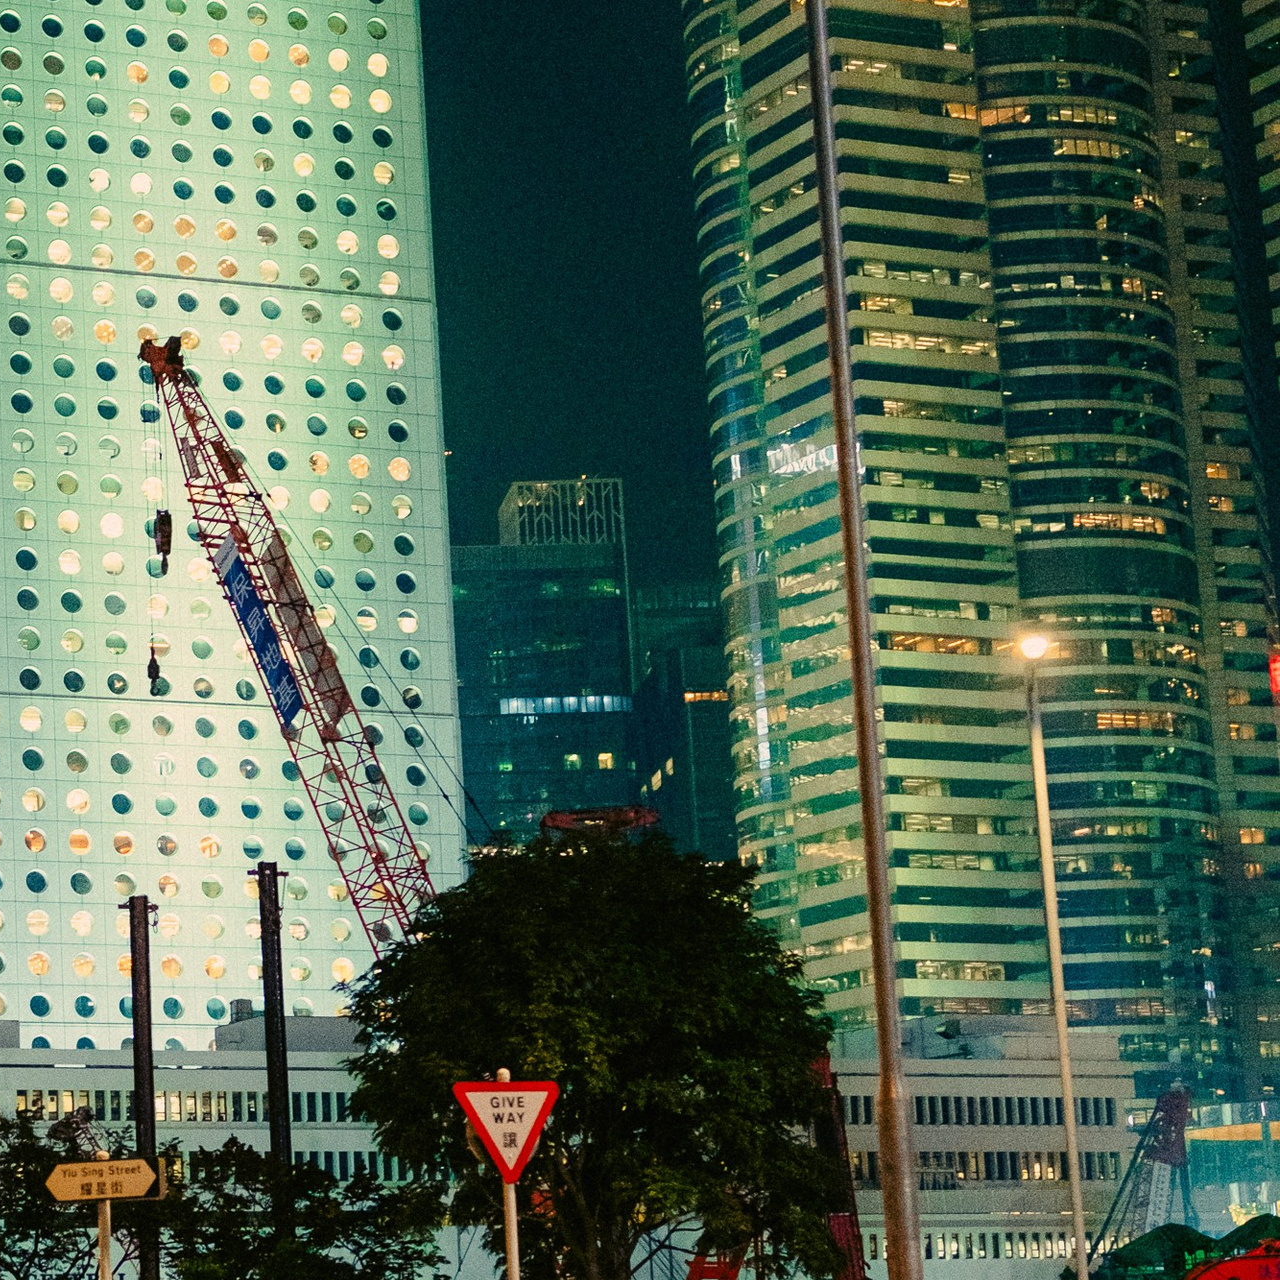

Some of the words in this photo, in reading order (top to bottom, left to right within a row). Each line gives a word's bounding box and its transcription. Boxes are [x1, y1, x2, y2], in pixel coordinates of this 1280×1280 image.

[490, 1096, 525, 1109] GIVE
[492, 1111, 525, 1124] WAY
[61, 1168, 78, 1178] Yiu
[81, 1167, 104, 1178] Sing
[108, 1165, 141, 1176] Street
